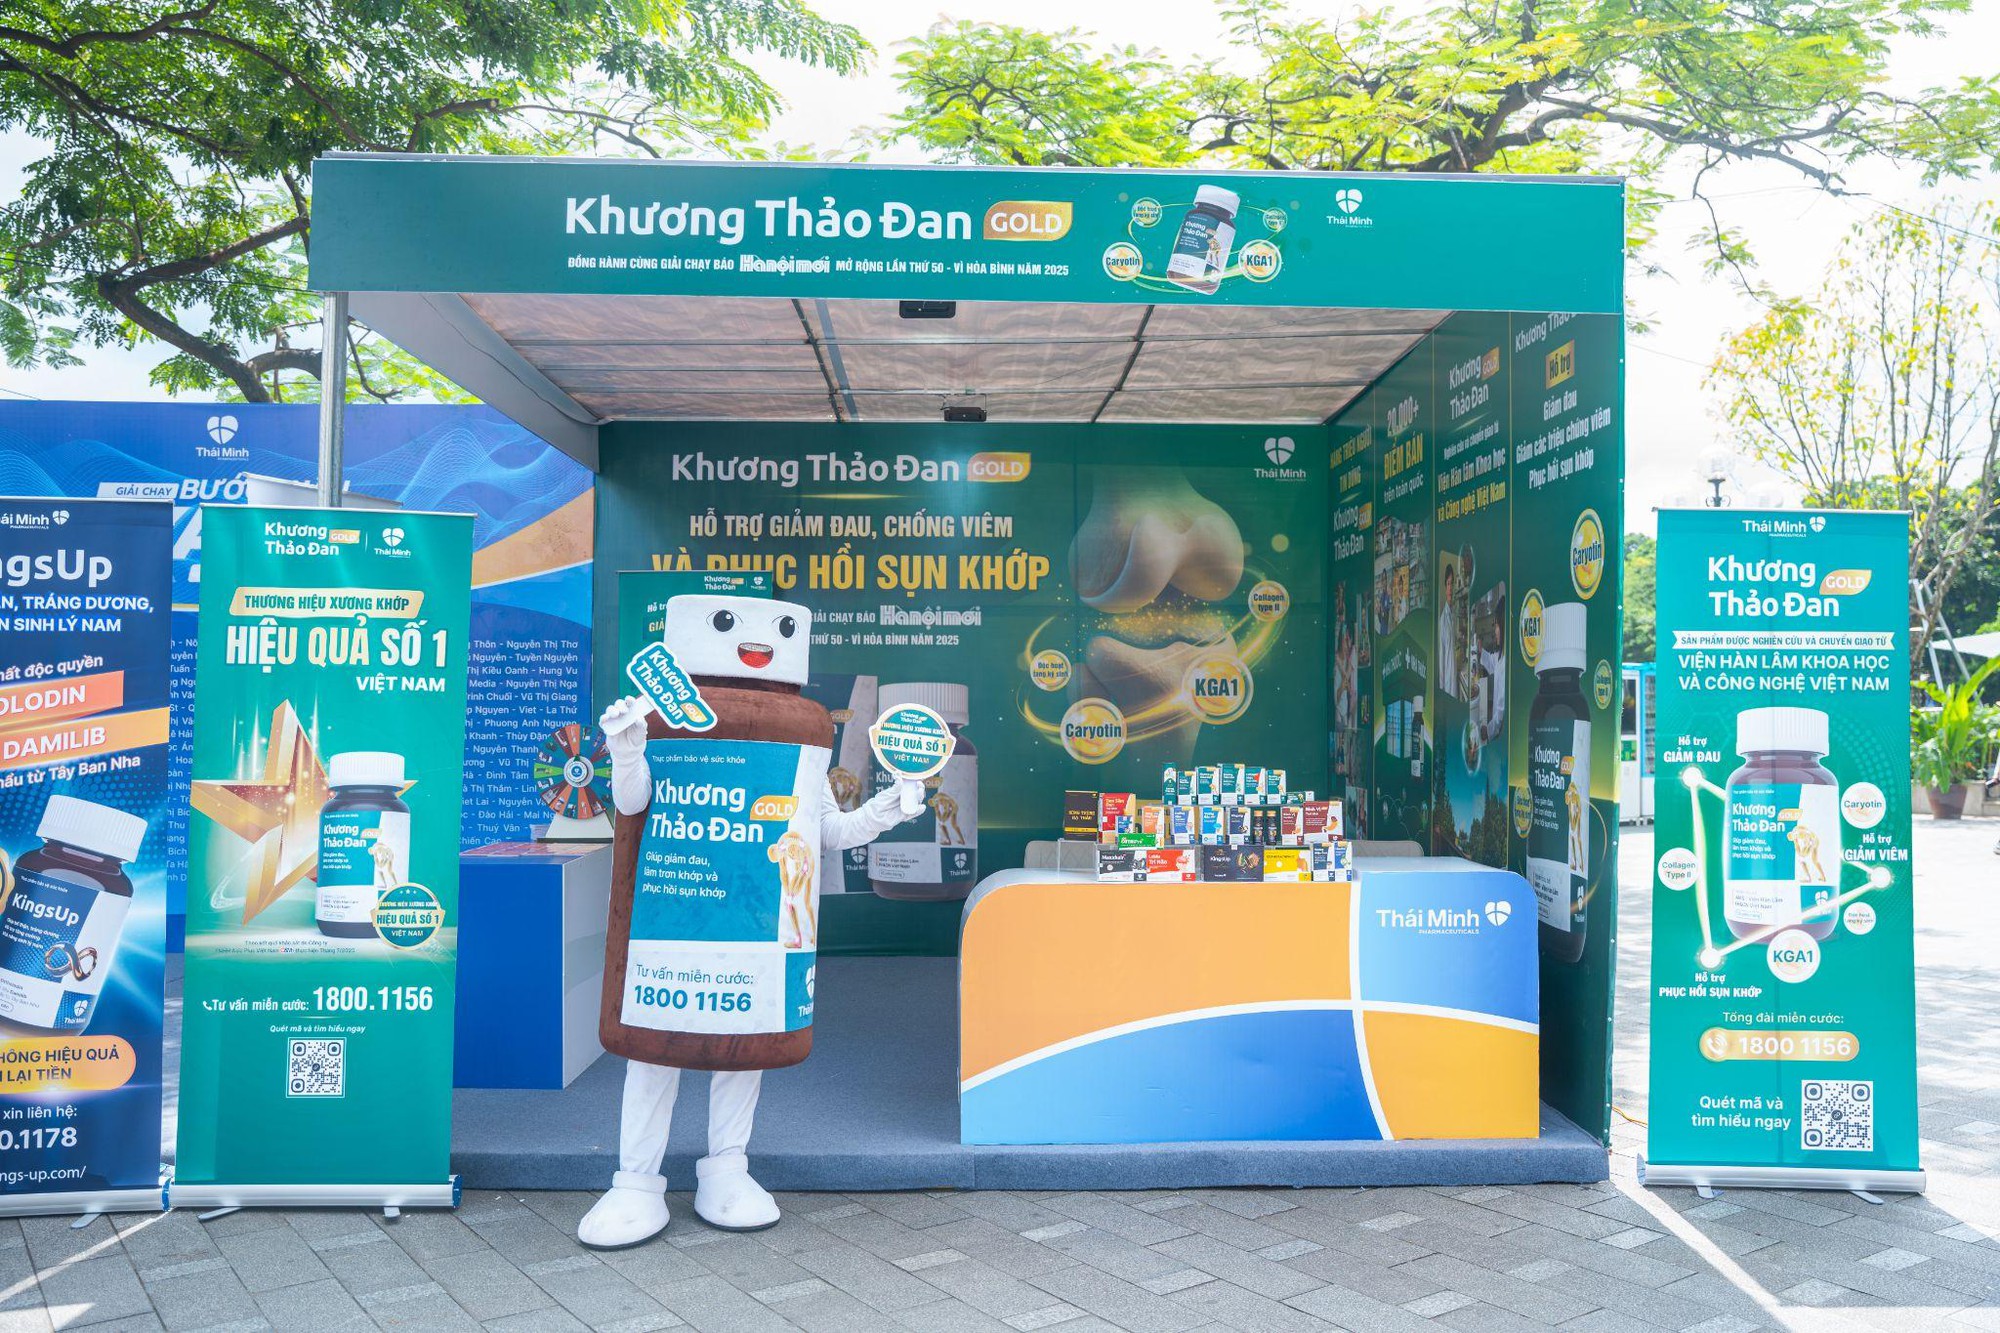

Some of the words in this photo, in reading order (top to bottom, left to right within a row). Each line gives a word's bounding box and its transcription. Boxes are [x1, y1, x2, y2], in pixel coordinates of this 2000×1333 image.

[566, 194, 745, 245] Khương
[755, 196, 872, 238] Thảo
[879, 201, 972, 240] Đan
[990, 212, 1062, 234] GOLD
[1326, 215, 1347, 225] Thái
[1349, 216, 1373, 225] Minh
[599, 254, 627, 270] HÀNH
[630, 255, 658, 270] CÙNG
[661, 254, 682, 270] GIẢI
[684, 258, 711, 272] CHẠY
[714, 256, 734, 271] BÁO
[836, 257, 853, 272] MỞ
[855, 259, 884, 275] RỘNG
[909, 260, 930, 273] THỨ
[931, 261, 944, 273] 50
[954, 260, 964, 274] VÌ
[966, 260, 987, 274] HÒA
[989, 260, 1015, 275] BÌNH
[1017, 261, 1042, 275] NĂM
[1044, 264, 1069, 276] 2025
[1105, 256, 1140, 268] Caryotin
[1246, 254, 1273, 267] KGA1
[1543, 395, 1562, 421] Giảm
[1563, 390, 1577, 411] đau
[1590, 406, 1611, 432] viêm
[672, 451, 799, 488] Khương
[805, 451, 889, 482] Thảo
[893, 454, 960, 482] Đan
[972, 461, 1024, 476] GOLD
[1254, 468, 1278, 478] Thái
[1279, 468, 1306, 478] Minh
[265, 522, 328, 540] Khương
[689, 507, 717, 537] HỖ
[724, 513, 764, 541] TRỢ
[769, 508, 823, 537] GIẢM
[829, 515, 877, 540] ĐAU,
[884, 508, 955, 537] CHỐNG
[961, 511, 1013, 538] VIÊM
[1742, 519, 1772, 532] Thái
[1774, 519, 1807, 533] Minh
[265, 540, 306, 555] Thảo
[307, 542, 340, 556] Đan
[1573, 540, 1602, 566] Caryotin
[809, 542, 865, 589] HỒI
[877, 554, 947, 598] SỤN
[959, 548, 1050, 590] KHỚP
[1708, 555, 1816, 588] Khương
[1825, 575, 1866, 589] GOLD
[22, 592, 81, 610] TRÁNG
[85, 596, 154, 613] DƯƠNG,
[244, 594, 295, 609] THƯƠNG
[298, 594, 326, 612] HIỆU
[330, 595, 373, 610] XƯƠNG
[376, 595, 410, 611] KHỚP
[1708, 589, 1778, 617] Thảo
[1783, 592, 1840, 617] Đan
[13, 618, 55, 632] SINH
[58, 615, 78, 632] LÝ
[81, 619, 122, 632] NAM
[829, 612, 854, 625] CHẠY
[856, 611, 876, 623] BÁO
[1523, 616, 1541, 638] KGA1
[226, 617, 298, 673] HIỆU
[308, 615, 370, 668] QUẢ
[380, 619, 428, 667] SỐ
[432, 630, 447, 668] 1
[810, 633, 830, 645] THỨ
[830, 634, 843, 645] 50
[851, 632, 861, 645] VÌ
[863, 633, 883, 645] HÒA
[885, 632, 909, 645] BÌNH
[910, 633, 933, 645] NĂM
[935, 635, 959, 646] 2025
[24, 662, 54, 680] độc
[57, 654, 104, 675] quyền
[505, 666, 529, 675] Oanh
[539, 666, 563, 676] Hung
[566, 667, 578, 675] Vu
[1678, 651, 1718, 672] VIỆN
[1720, 651, 1758, 669] HÀN
[1762, 652, 1798, 669] LÂM
[1801, 655, 1850, 670] KHOA
[1853, 655, 1890, 673] HỌC
[356, 673, 398, 694] VIỆT
[401, 677, 446, 692] NAM
[469, 679, 496, 688] Media
[1195, 678, 1239, 697] KGA1
[1678, 672, 1701, 690] VÀ
[1704, 672, 1756, 691] CÔNG
[1759, 672, 1806, 694] NGHỆ
[1809, 673, 1848, 694] VIỆT
[1851, 677, 1890, 691] NAM
[1065, 722, 1122, 739] Caryotin
[3, 727, 106, 760] DAMILIB
[1678, 735, 1690, 746] Hỗ
[1693, 736, 1708, 747] trợ
[1663, 748, 1693, 763] GIẢM
[1695, 751, 1721, 763] ĐAU
[655, 778, 746, 813] Khương
[1844, 799, 1883, 811] Caryotin
[754, 802, 794, 817] GOLD
[651, 812, 704, 841] Thảo
[707, 817, 764, 843] Đan
[1862, 833, 1874, 844] Hỗ
[1877, 834, 1893, 846] trợ
[1844, 846, 1876, 862] GIẢM
[1878, 847, 1908, 862] VIÊM
[11, 892, 80, 927] KingsUp
[1375, 908, 1423, 927] Thái
[1428, 909, 1480, 927] Minh
[1773, 949, 1814, 963] KGA1
[636, 964, 649, 977] Tư
[651, 966, 673, 981] vấn
[677, 969, 711, 984] miễn
[715, 972, 754, 985] cước:
[1694, 971, 1708, 983] Hỗ
[1710, 973, 1726, 984] trợ
[211, 999, 227, 1011] Tư
[229, 997, 248, 1011] vấn
[252, 997, 279, 1011] miễn
[281, 998, 309, 1011] cước:
[312, 986, 433, 1011] 1800.1156
[634, 985, 688, 1010] 1800
[694, 991, 752, 1012] 1156
[1659, 987, 1686, 1000] PHỤC
[1709, 987, 1730, 1000] SỤN
[1733, 985, 1763, 998] KHỚP
[1755, 1012, 1775, 1023] đài
[1777, 1011, 1807, 1024] miễn
[1809, 1012, 1845, 1024] cước:
[45, 1046, 82, 1064] HIỆU
[86, 1044, 120, 1060] QUẢ
[1738, 1036, 1794, 1055] 1800
[1800, 1037, 1851, 1056] 1156
[1699, 1095, 1735, 1110] Quét
[1739, 1097, 1763, 1110] mã
[1766, 1097, 1784, 1110] và
[3, 1107, 23, 1120] xin
[27, 1106, 52, 1119] liên
[56, 1105, 78, 1120] hệ:
[1692, 1113, 1715, 1128] tìm
[1719, 1112, 1751, 1128] hiểu
[1754, 1116, 1791, 1131] ngay
